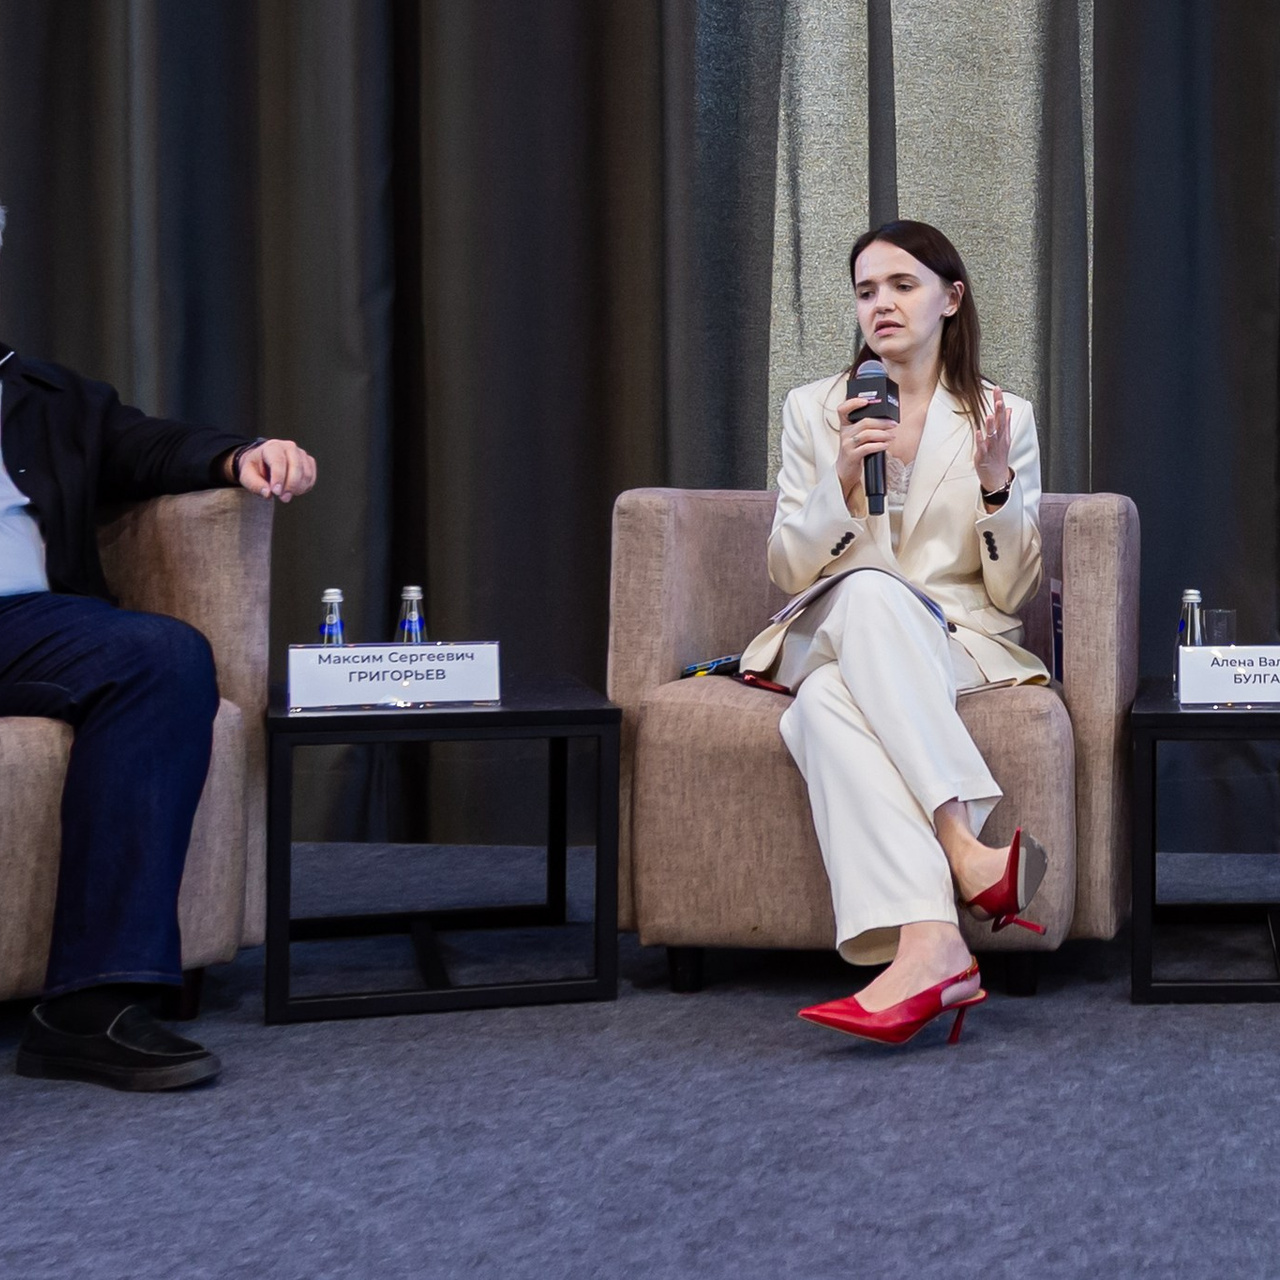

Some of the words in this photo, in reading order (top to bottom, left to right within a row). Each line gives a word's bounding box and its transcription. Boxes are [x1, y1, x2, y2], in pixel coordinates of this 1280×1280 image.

[317, 653, 383, 665] Максим
[387, 651, 475, 666] Сергеевич
[1210, 656, 1254, 668] Алена
[348, 669, 447, 683] ГРИГОРЬЕВ
